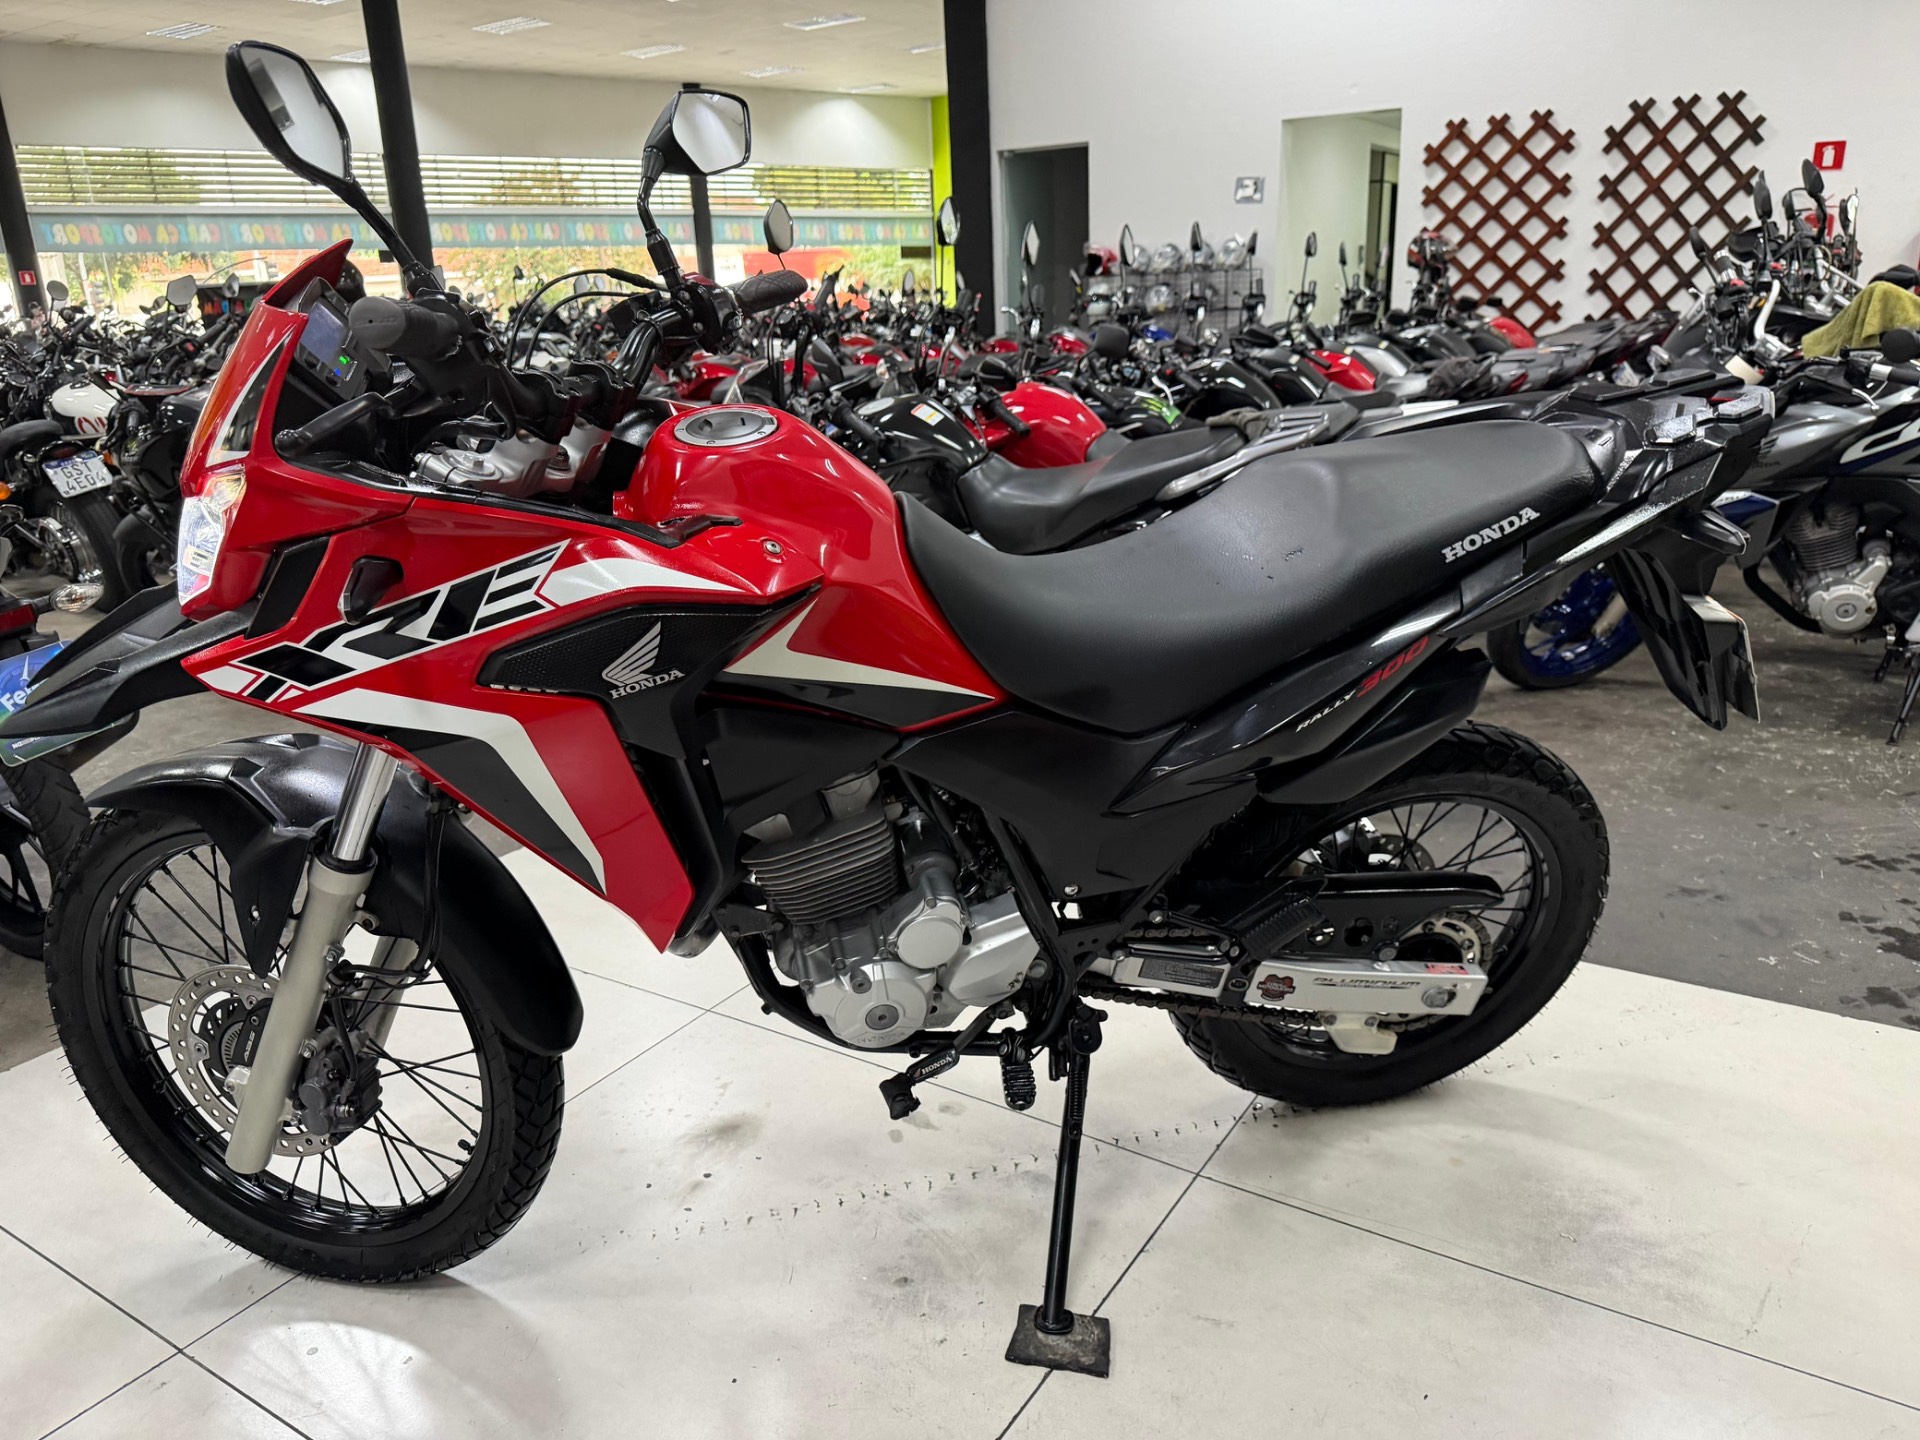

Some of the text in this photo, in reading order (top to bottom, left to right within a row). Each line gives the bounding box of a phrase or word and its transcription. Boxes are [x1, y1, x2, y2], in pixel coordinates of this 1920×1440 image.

[61, 462, 92, 479] GST
[1441, 507, 1540, 563] HONDA
[609, 669, 685, 699] HONDA
[1296, 636, 1429, 733] RALLY 300
[244, 1030, 255, 1063] ABS
[922, 1056, 953, 1075] HONDA
